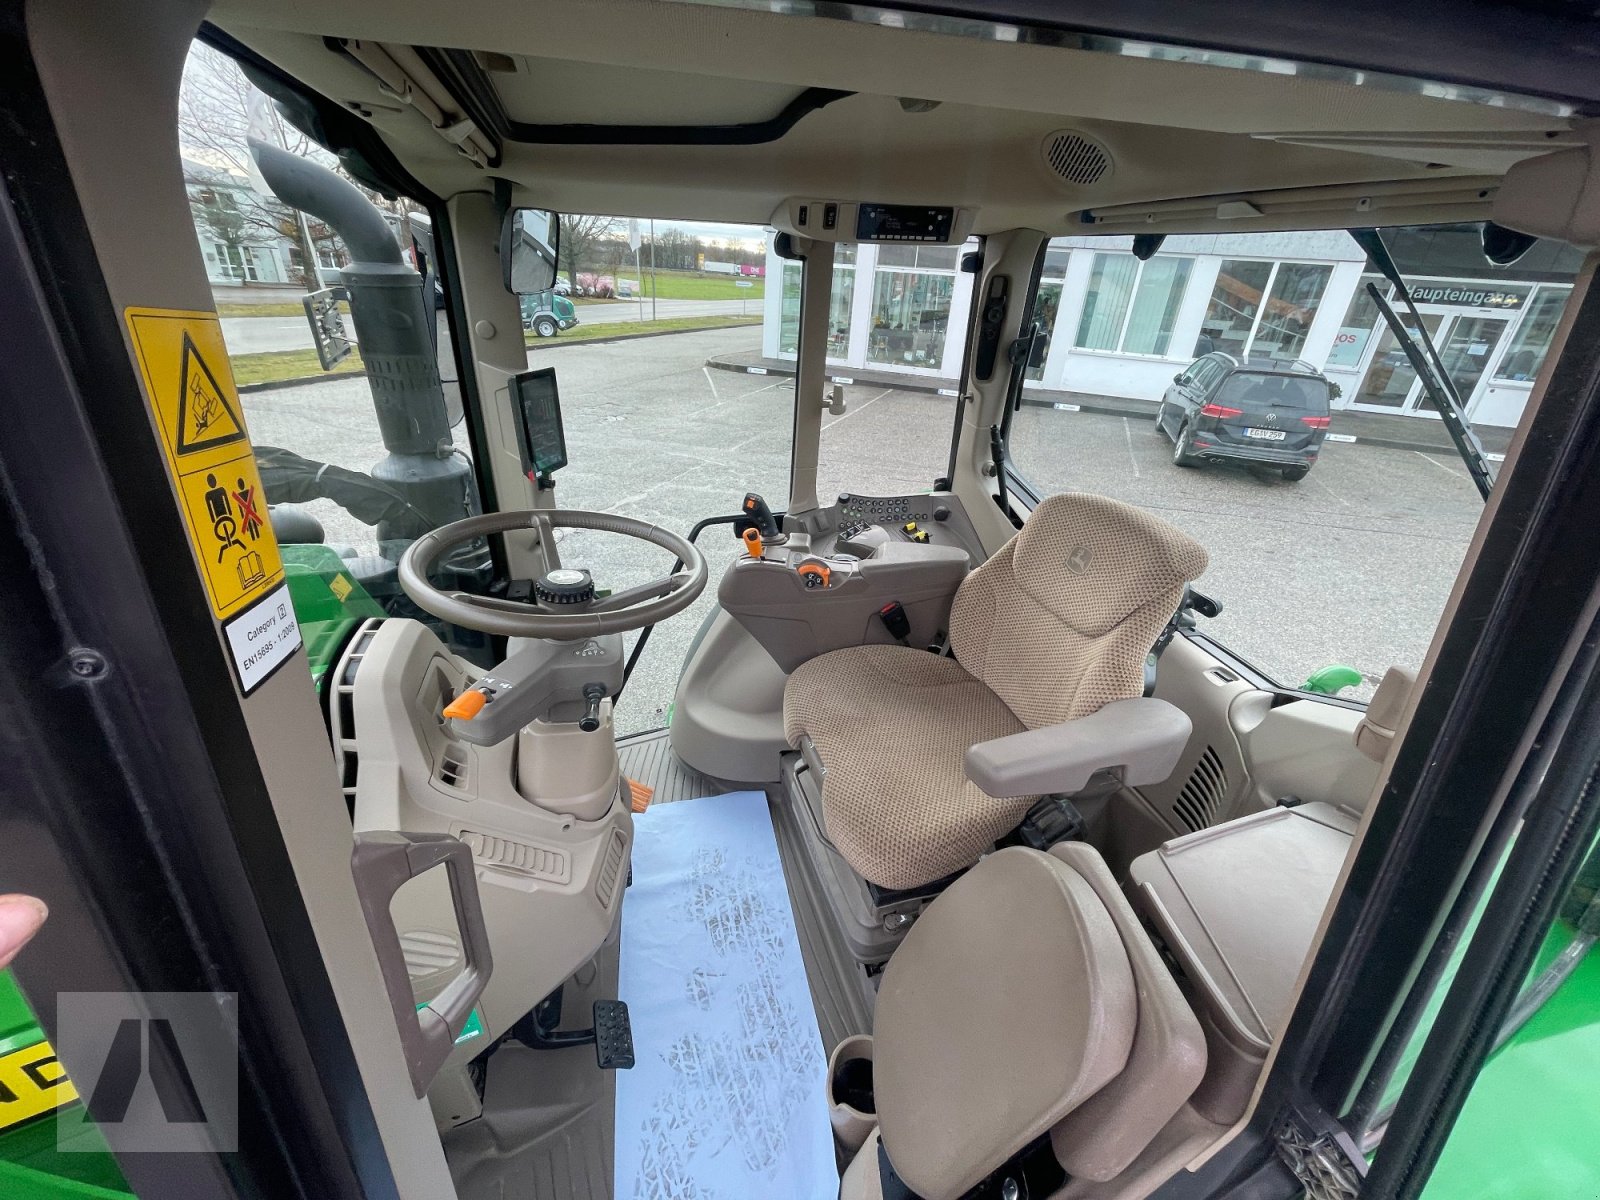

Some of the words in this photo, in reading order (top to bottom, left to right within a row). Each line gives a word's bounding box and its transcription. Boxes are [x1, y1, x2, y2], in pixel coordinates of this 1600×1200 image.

[1405, 284, 1517, 307] Haupteingang
[247, 615, 276, 642] Category
[243, 640, 274, 670] EN15695
